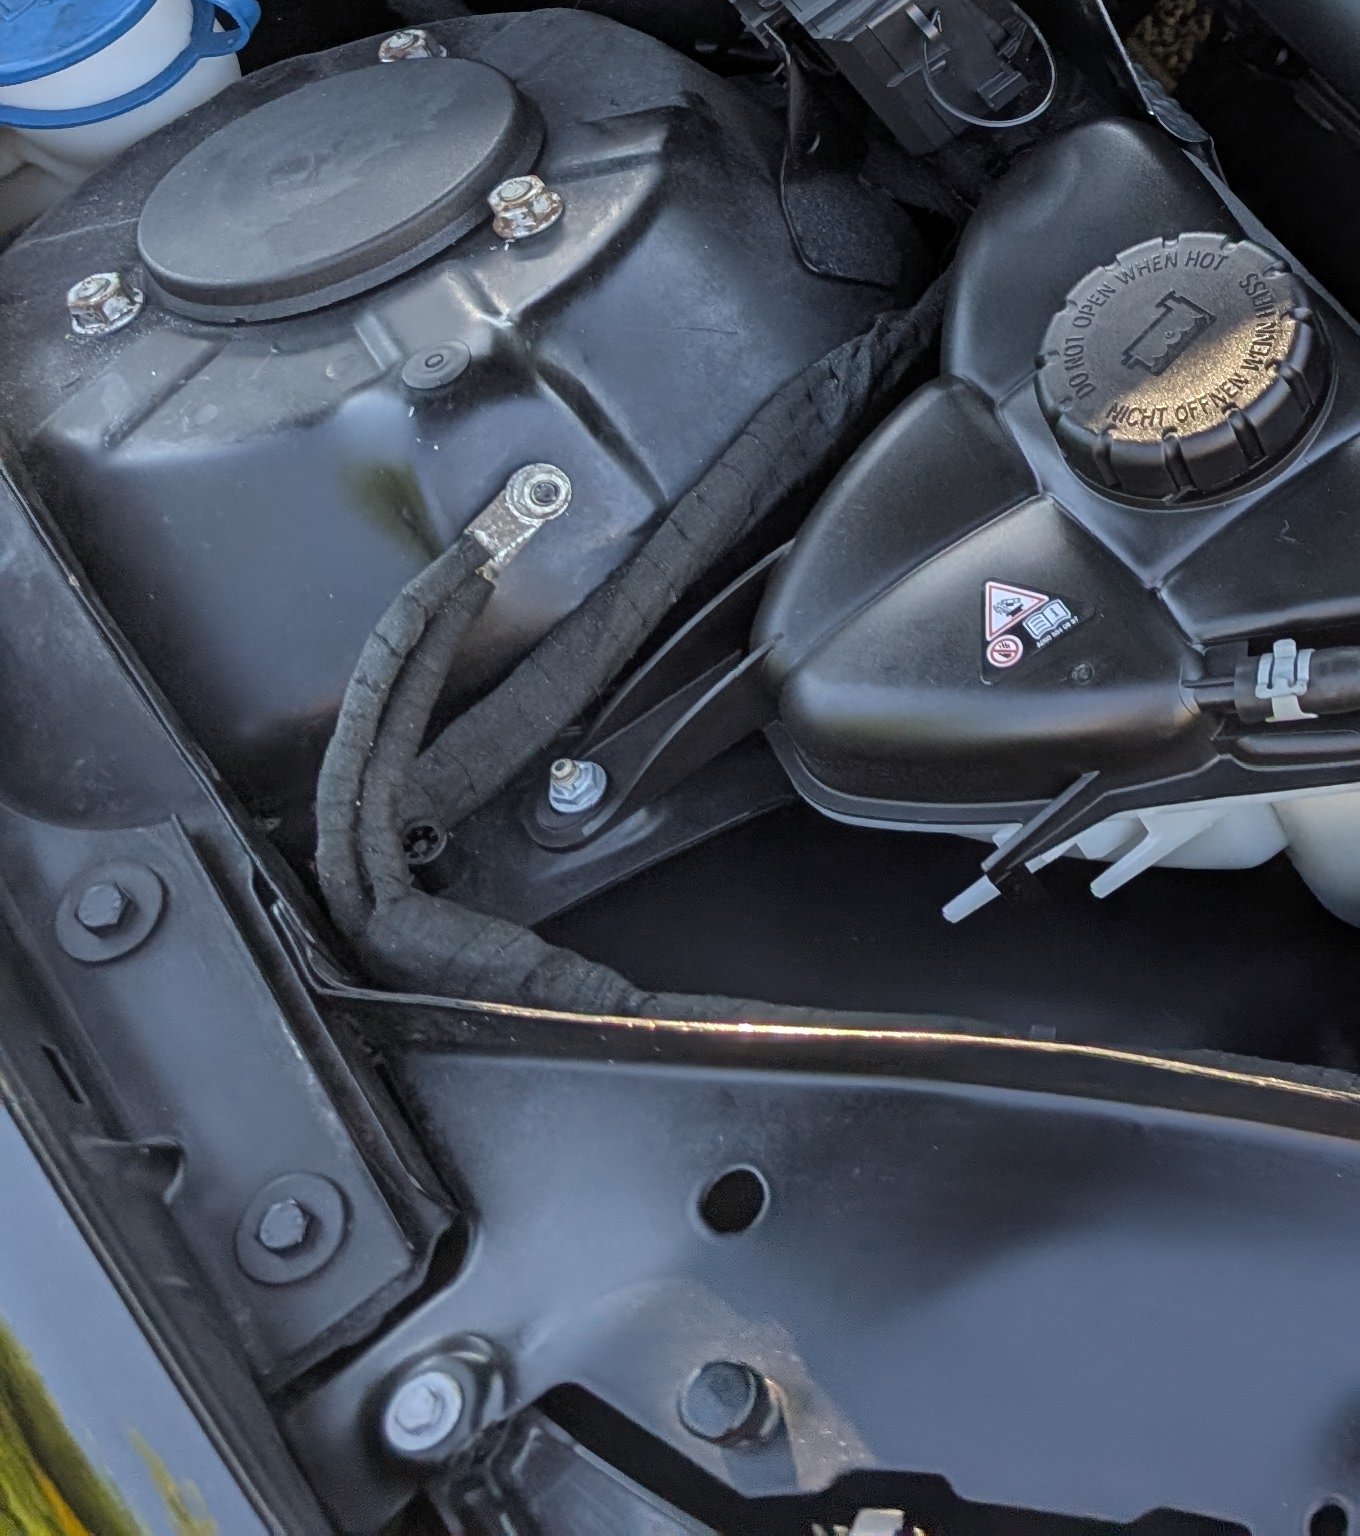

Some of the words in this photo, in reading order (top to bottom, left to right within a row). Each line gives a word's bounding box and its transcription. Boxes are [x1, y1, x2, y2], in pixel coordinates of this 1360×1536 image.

[1114, 250, 1178, 286] WHEN
[1184, 250, 1229, 272] HOT
[1071, 282, 1117, 330] OPEN
[1238, 272, 1275, 319] HEISS
[1064, 336, 1085, 373] NOT
[1241, 320, 1277, 373] WENN
[1068, 372, 1096, 401] DO
[1105, 402, 1168, 428] NICHT
